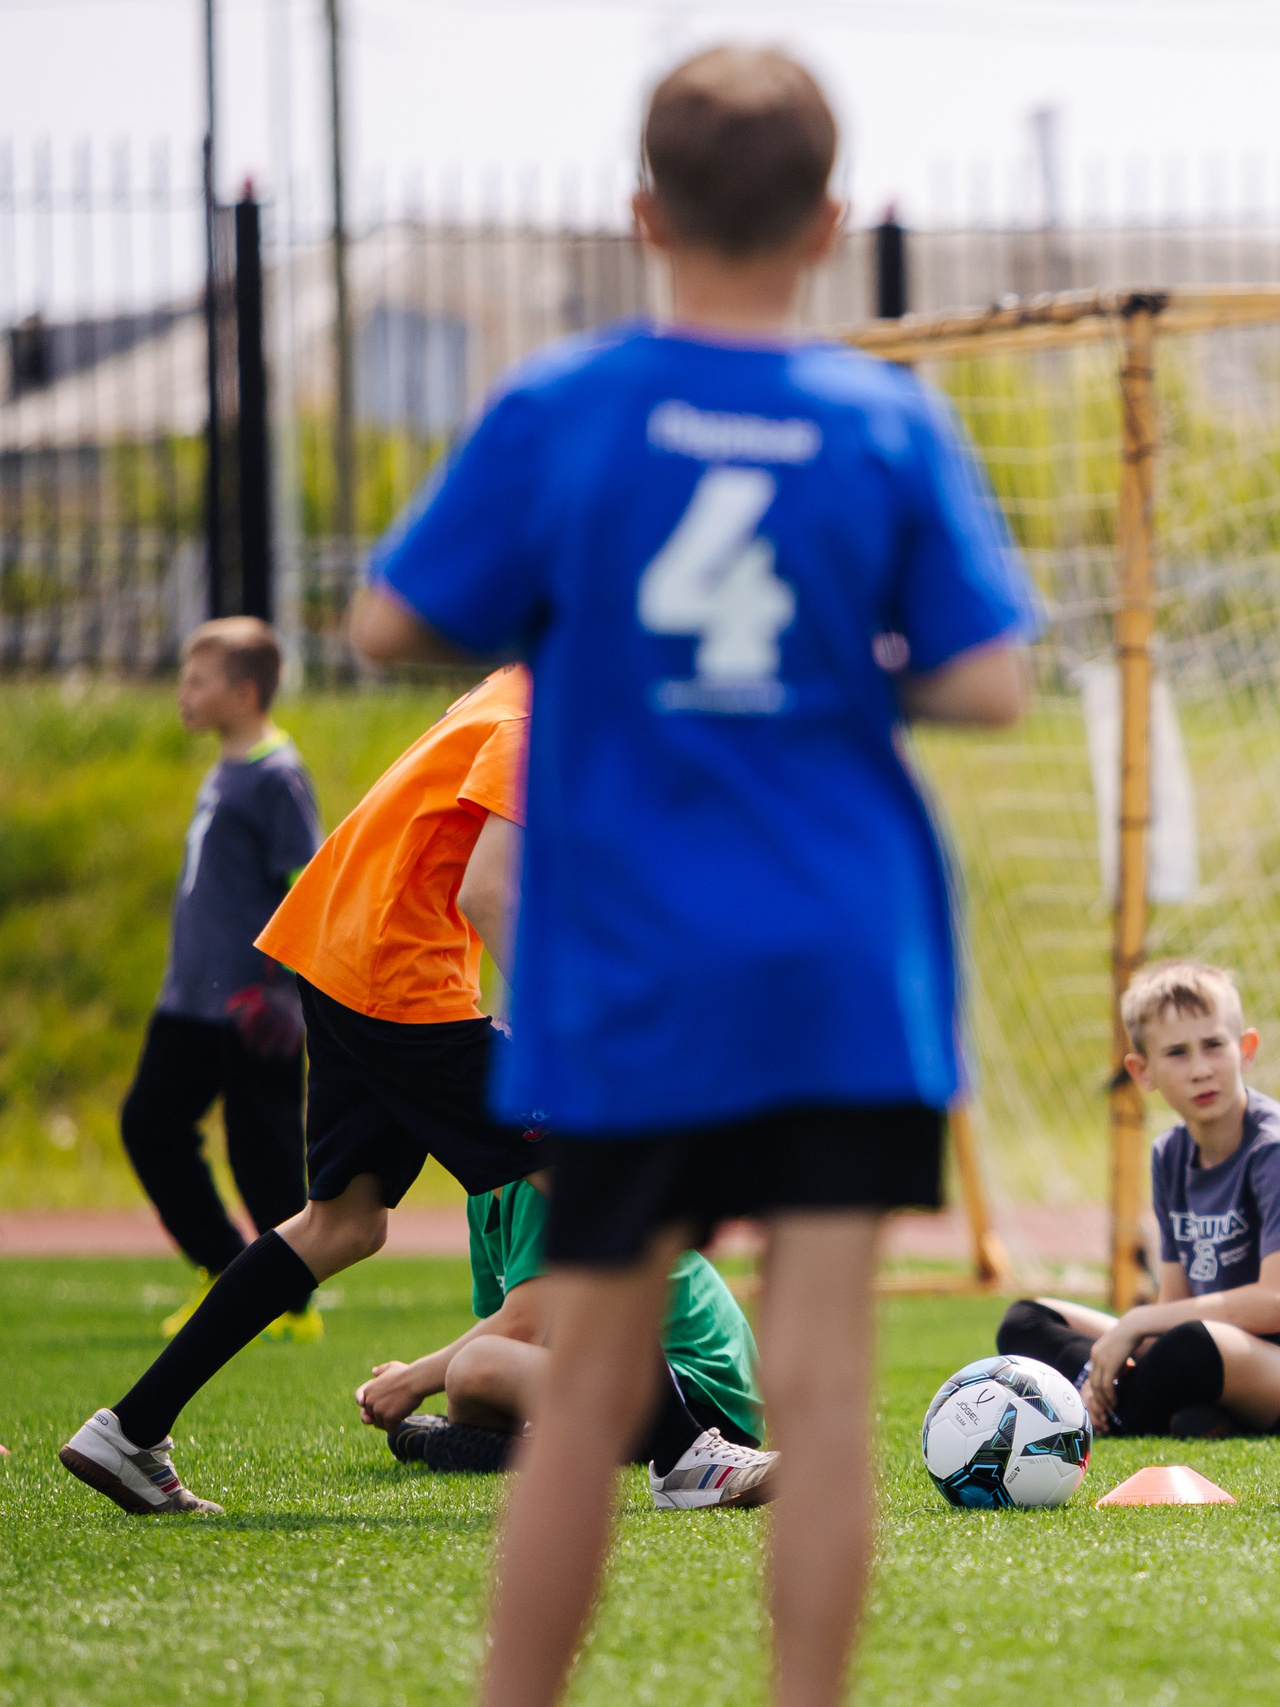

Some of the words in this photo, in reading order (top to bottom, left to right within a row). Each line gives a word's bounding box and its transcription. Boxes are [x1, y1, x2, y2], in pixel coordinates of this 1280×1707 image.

[637, 466, 797, 678] 4
[954, 1413, 967, 1427] TEAM
[956, 1401, 979, 1426] JÖGEL
